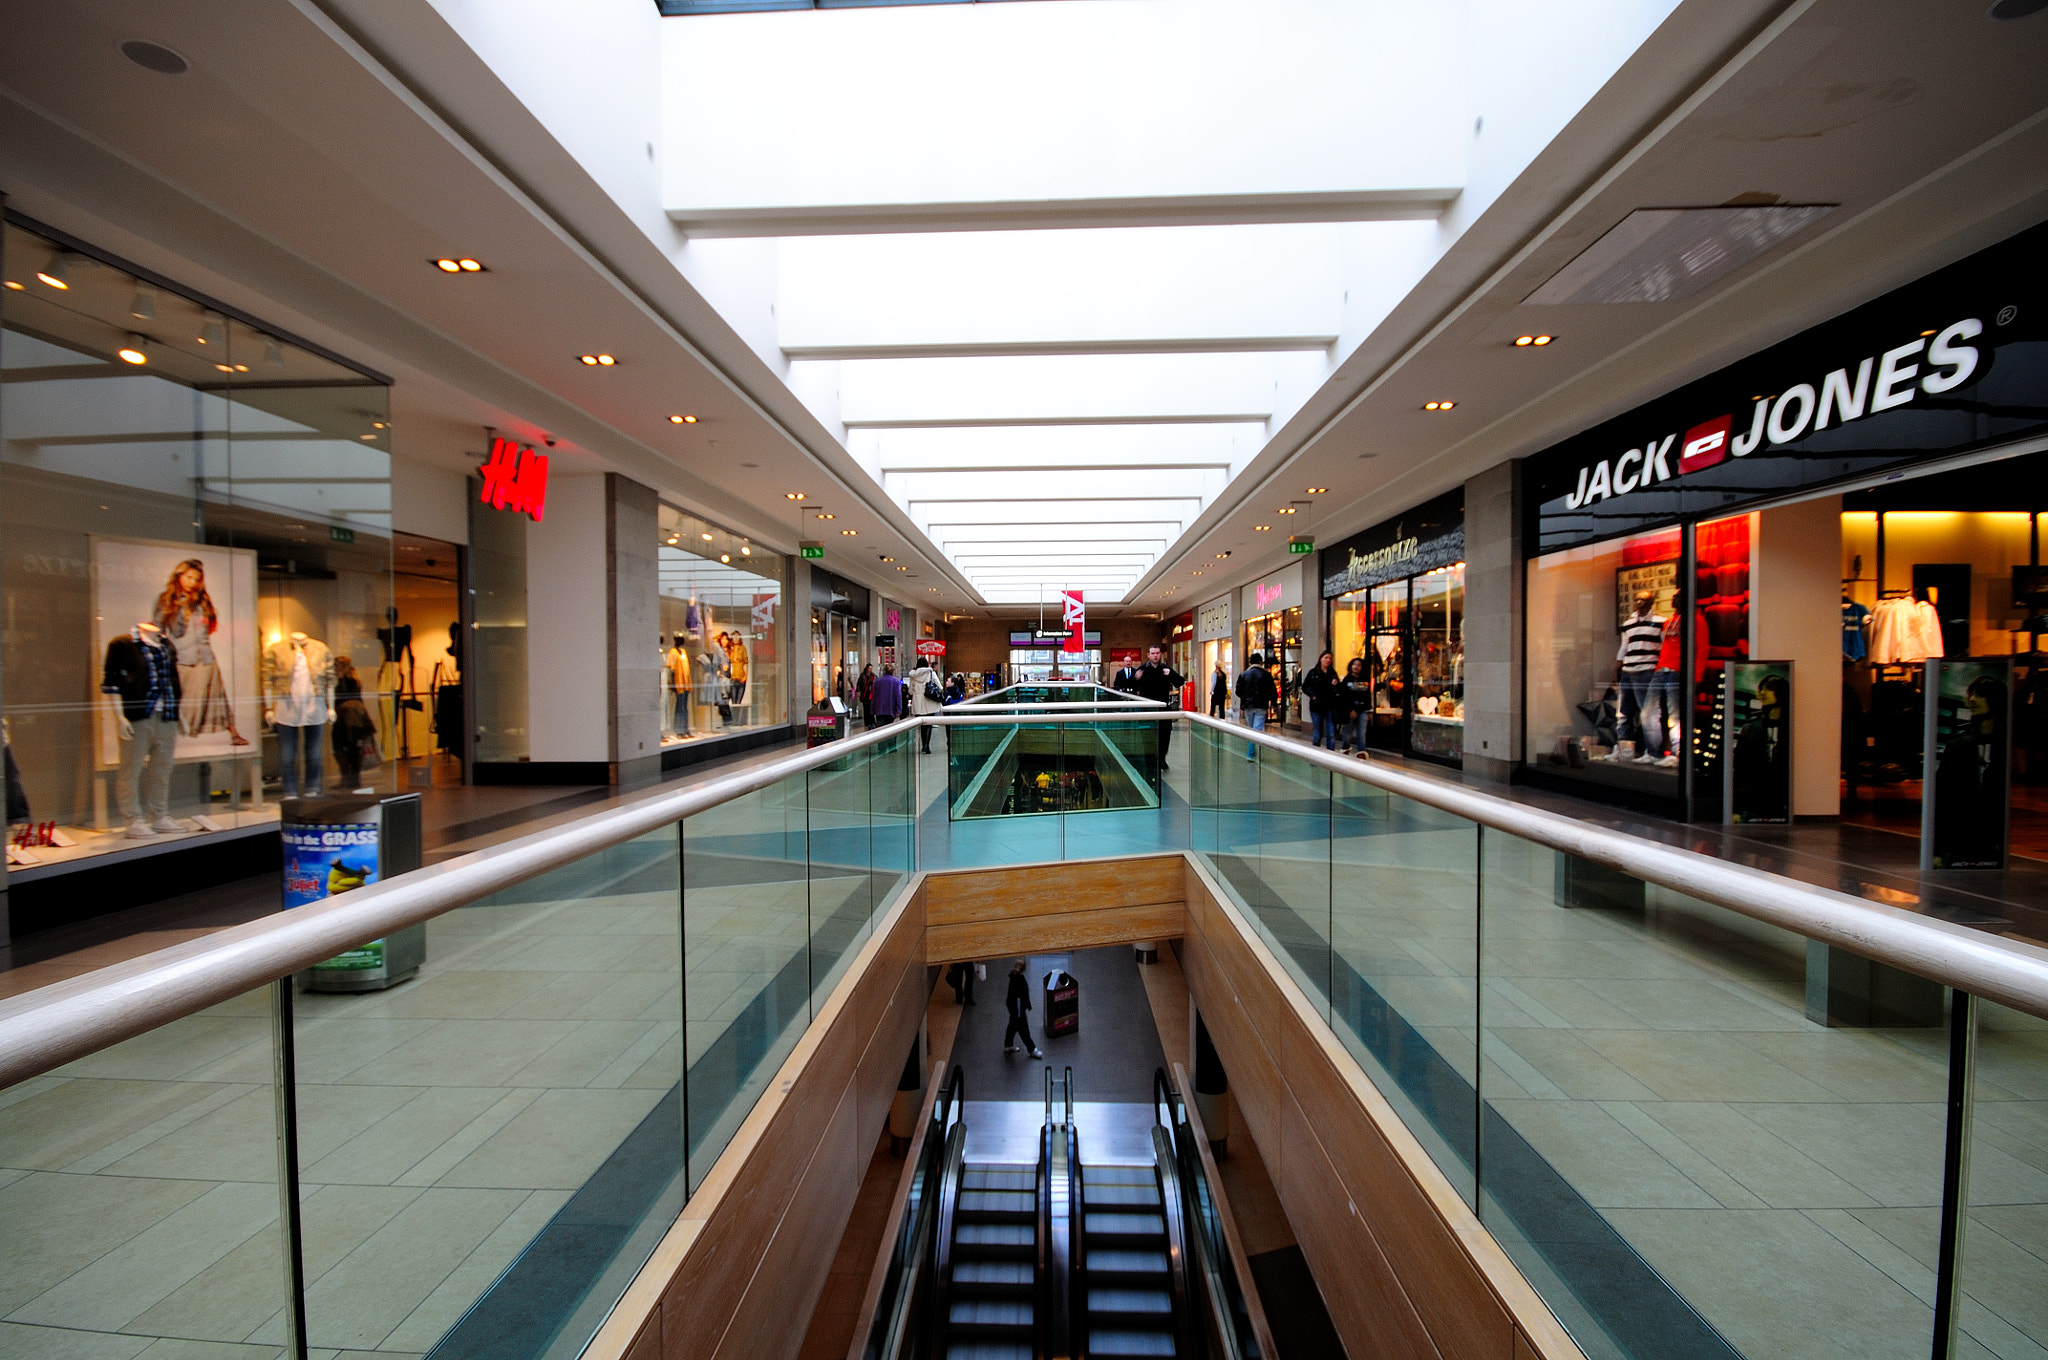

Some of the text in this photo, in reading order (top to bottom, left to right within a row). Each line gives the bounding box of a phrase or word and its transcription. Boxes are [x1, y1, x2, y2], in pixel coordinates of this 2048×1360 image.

[1566, 432, 1677, 510] JACK
[1730, 318, 1983, 458] JONES
[480, 437, 549, 522] H&M
[1200, 602, 1228, 633] TOPSHOP
[322, 831, 378, 845] GRASS
